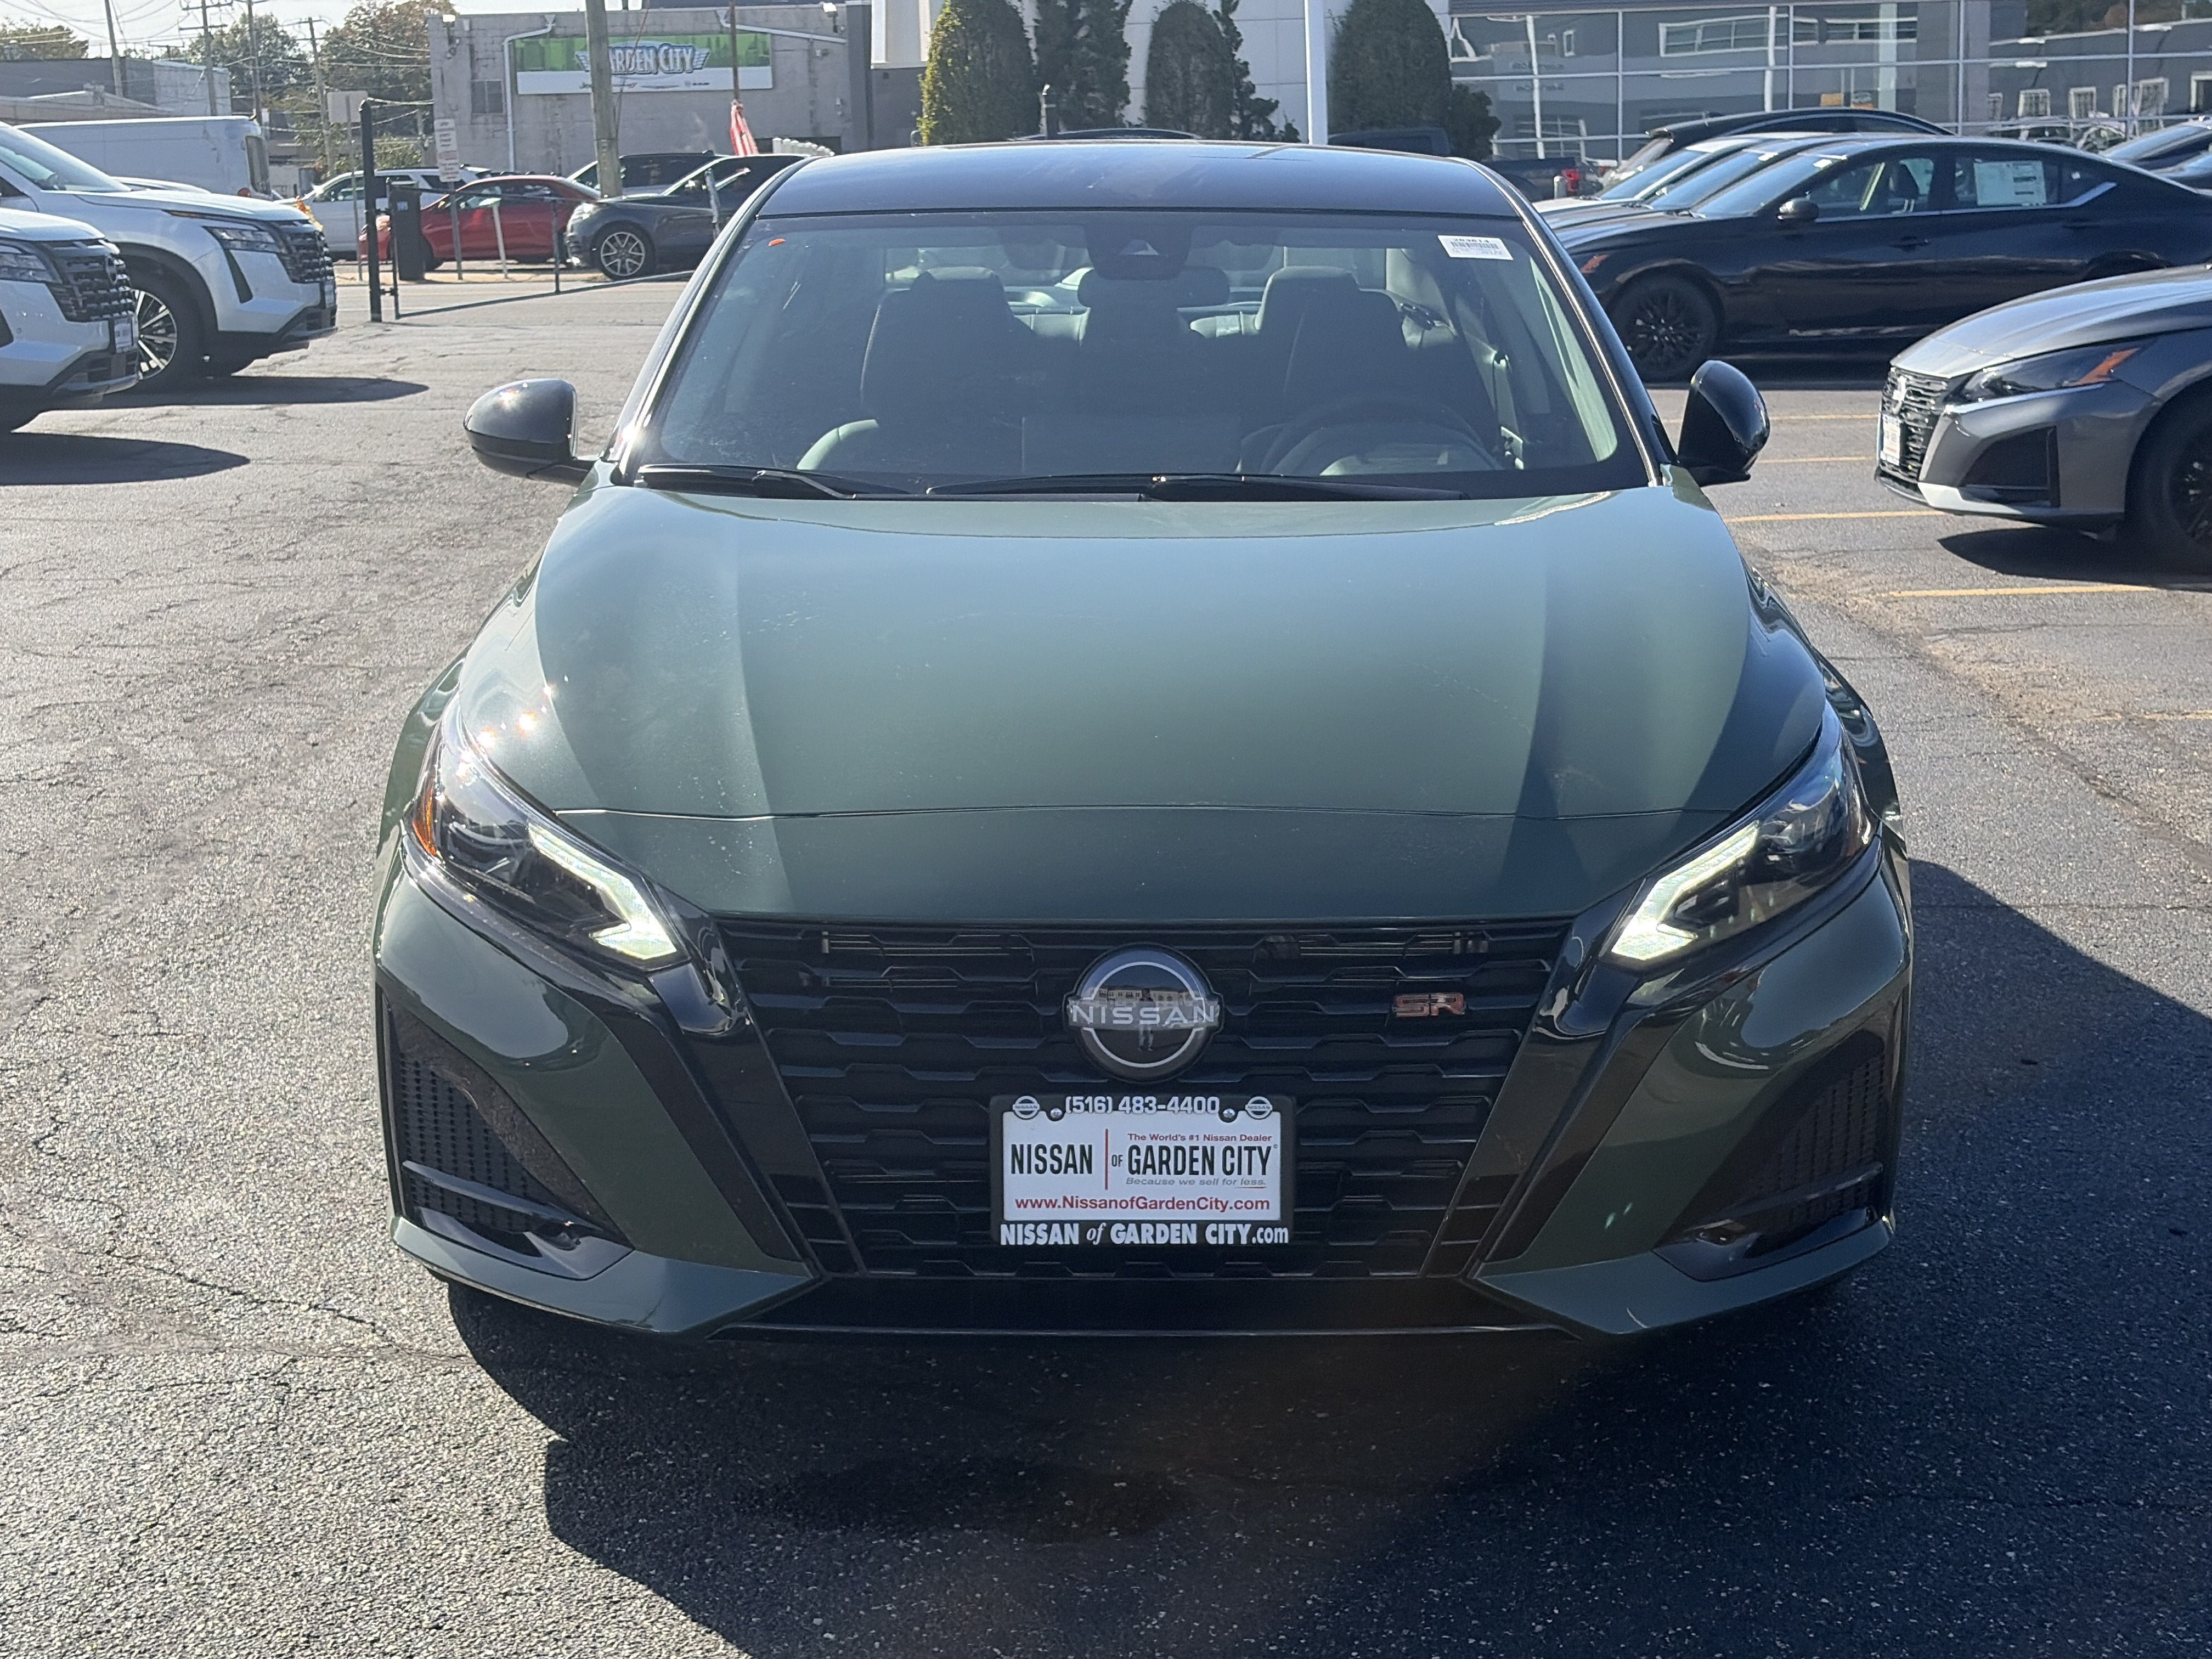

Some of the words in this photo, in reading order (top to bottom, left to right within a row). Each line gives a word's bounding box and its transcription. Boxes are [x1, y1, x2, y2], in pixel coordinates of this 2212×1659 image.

[608, 47, 658, 74] RDEN
[659, 43, 695, 74] CITY
[1072, 1005, 1214, 1025] NISSAN
[1393, 992, 1465, 1017] SR
[1065, 1096, 1113, 1114] (516)
[1118, 1096, 1220, 1114] 483-4400
[1011, 1144, 1092, 1175] NISSAN
[1111, 1154, 1123, 1167] OF
[1128, 1144, 1215, 1175] GARDEN
[1222, 1146, 1271, 1176] CITY
[1015, 1196, 1269, 1212] www.NissanofGardenCity.com
[1000, 1223, 1079, 1245] NISSAN
[1086, 1222, 1106, 1245] of
[1110, 1223, 1197, 1245] GARDEN
[1205, 1223, 1289, 1245] CITY.com
